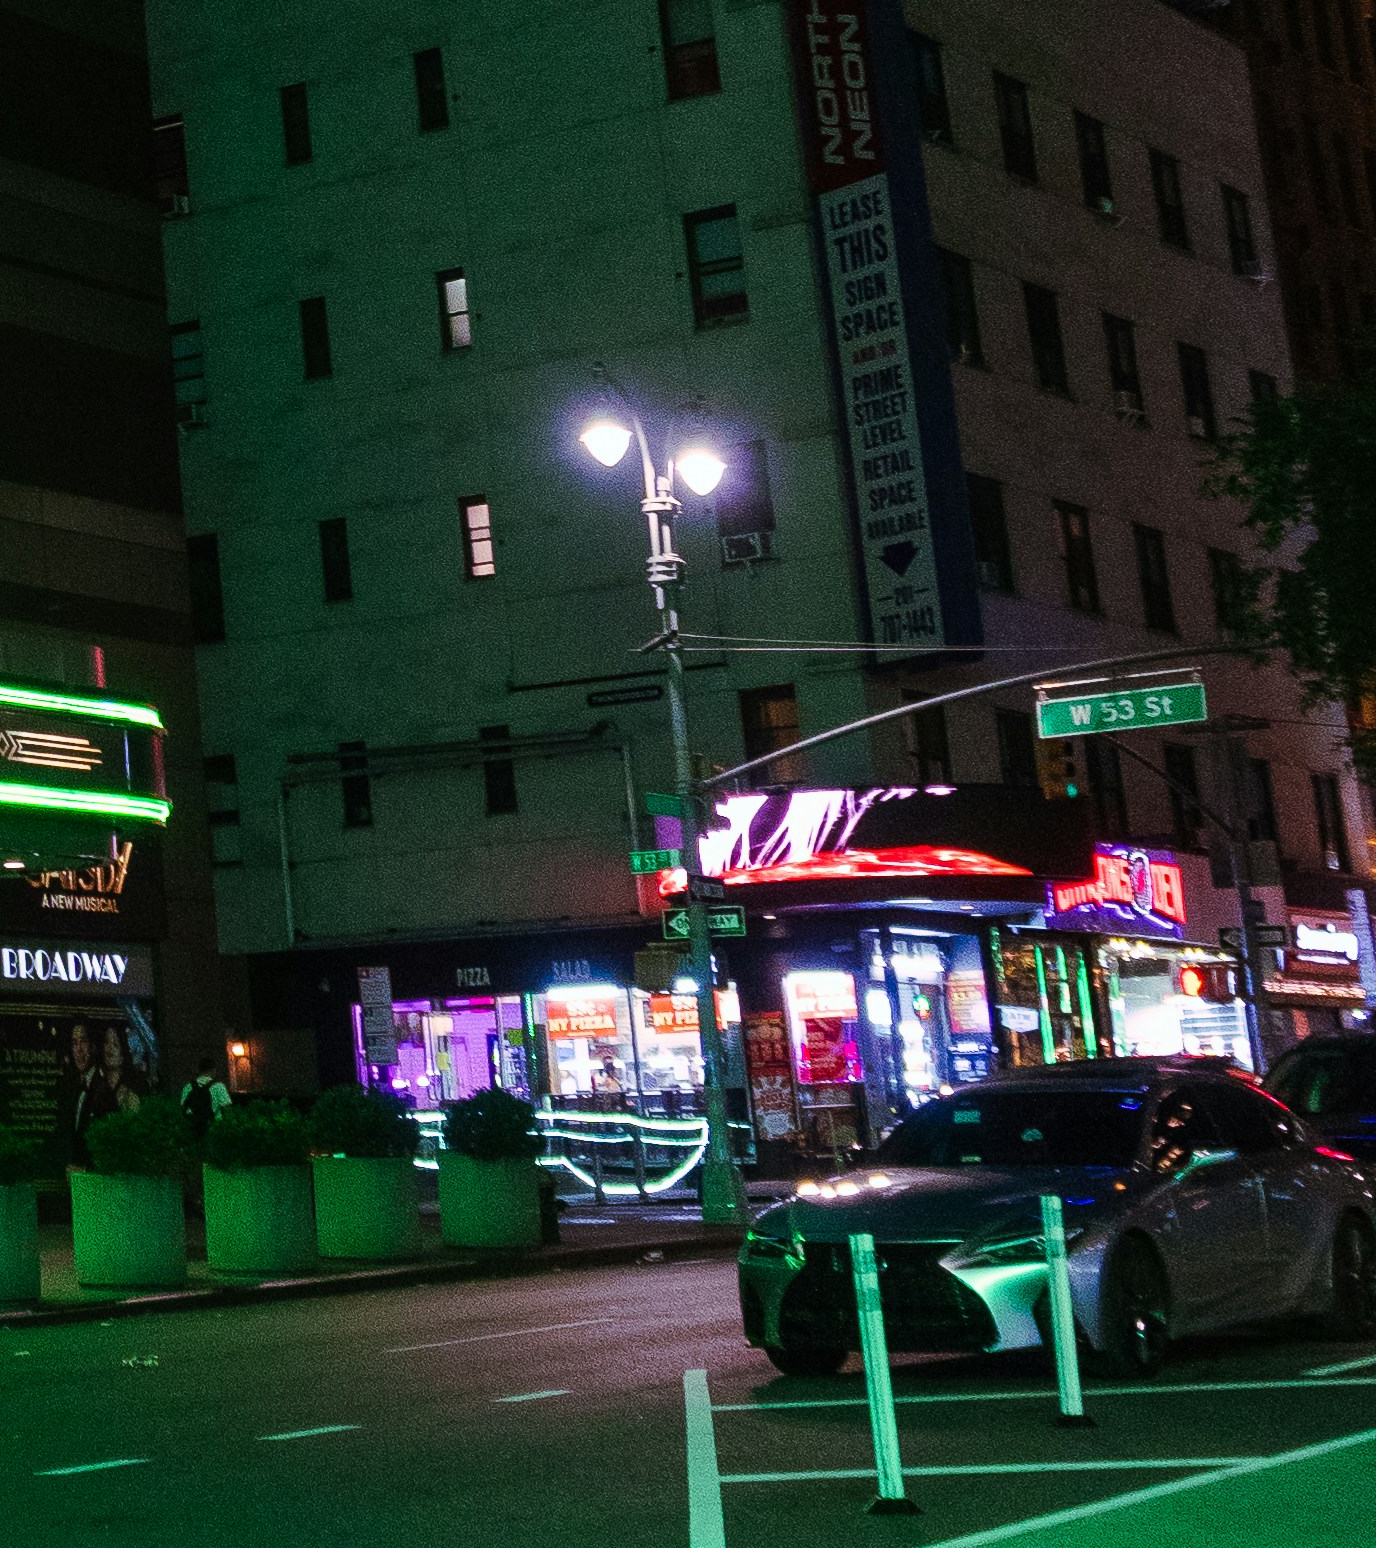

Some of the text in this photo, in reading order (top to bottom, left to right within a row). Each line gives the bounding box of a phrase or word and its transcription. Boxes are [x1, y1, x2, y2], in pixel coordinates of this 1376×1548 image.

[836, 13, 876, 161] NEON
[829, 190, 884, 230] LEASE
[834, 223, 888, 274] THIS
[845, 273, 888, 307] SIGN
[840, 302, 900, 342] SPACE
[852, 365, 904, 401] PRIME
[853, 391, 908, 426] STREET
[863, 419, 906, 449] LEVEL
[869, 480, 917, 512] SPACE
[1070, 696, 1173, 726] W 53 St
[42, 893, 121, 914] A NEW MUSICAL
[1, 947, 129, 984] BROADWAY
[456, 967, 491, 987] PIZZA
